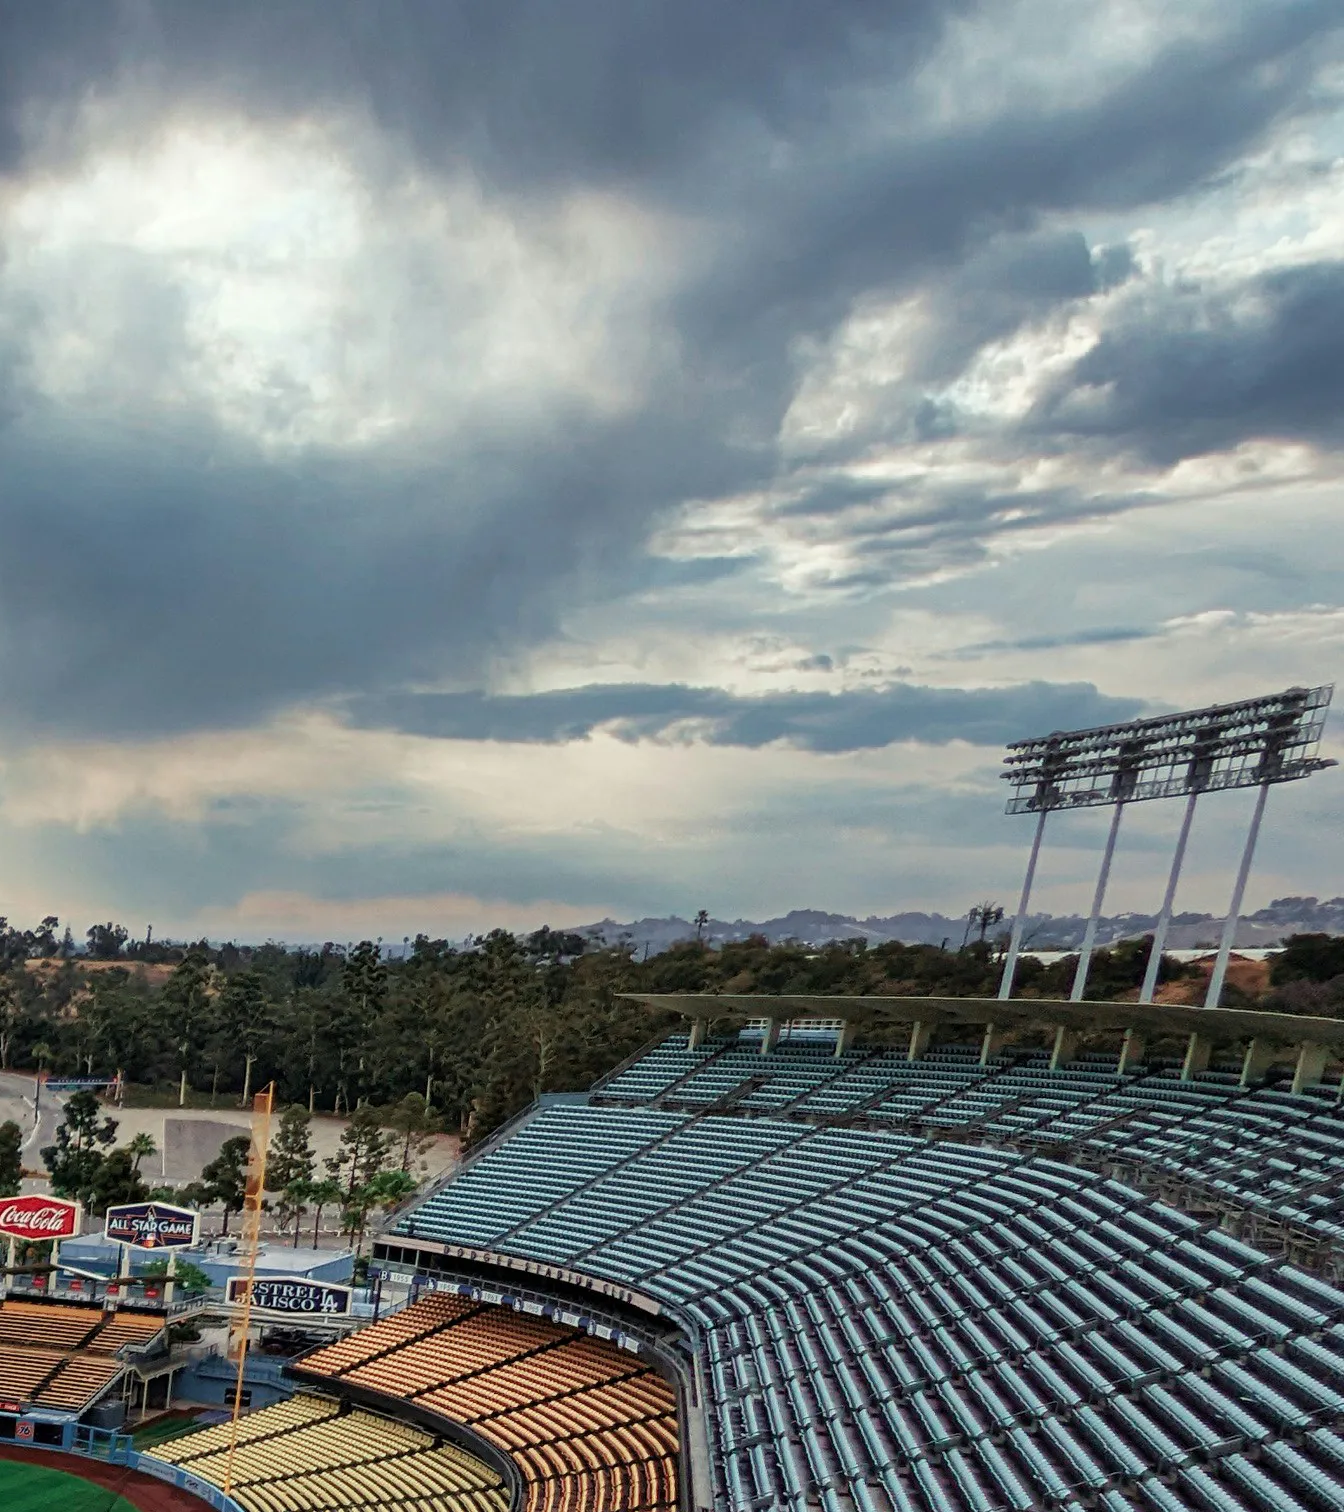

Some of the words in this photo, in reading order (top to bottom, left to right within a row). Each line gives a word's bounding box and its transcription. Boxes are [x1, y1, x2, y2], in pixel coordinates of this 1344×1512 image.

[0, 1206, 69, 1231] Coca-Cola
[110, 1218, 129, 1230] ALL
[132, 1220, 158, 1232] STAR
[158, 1221, 192, 1234] GAME
[236, 1292, 315, 1311] JALISCO
